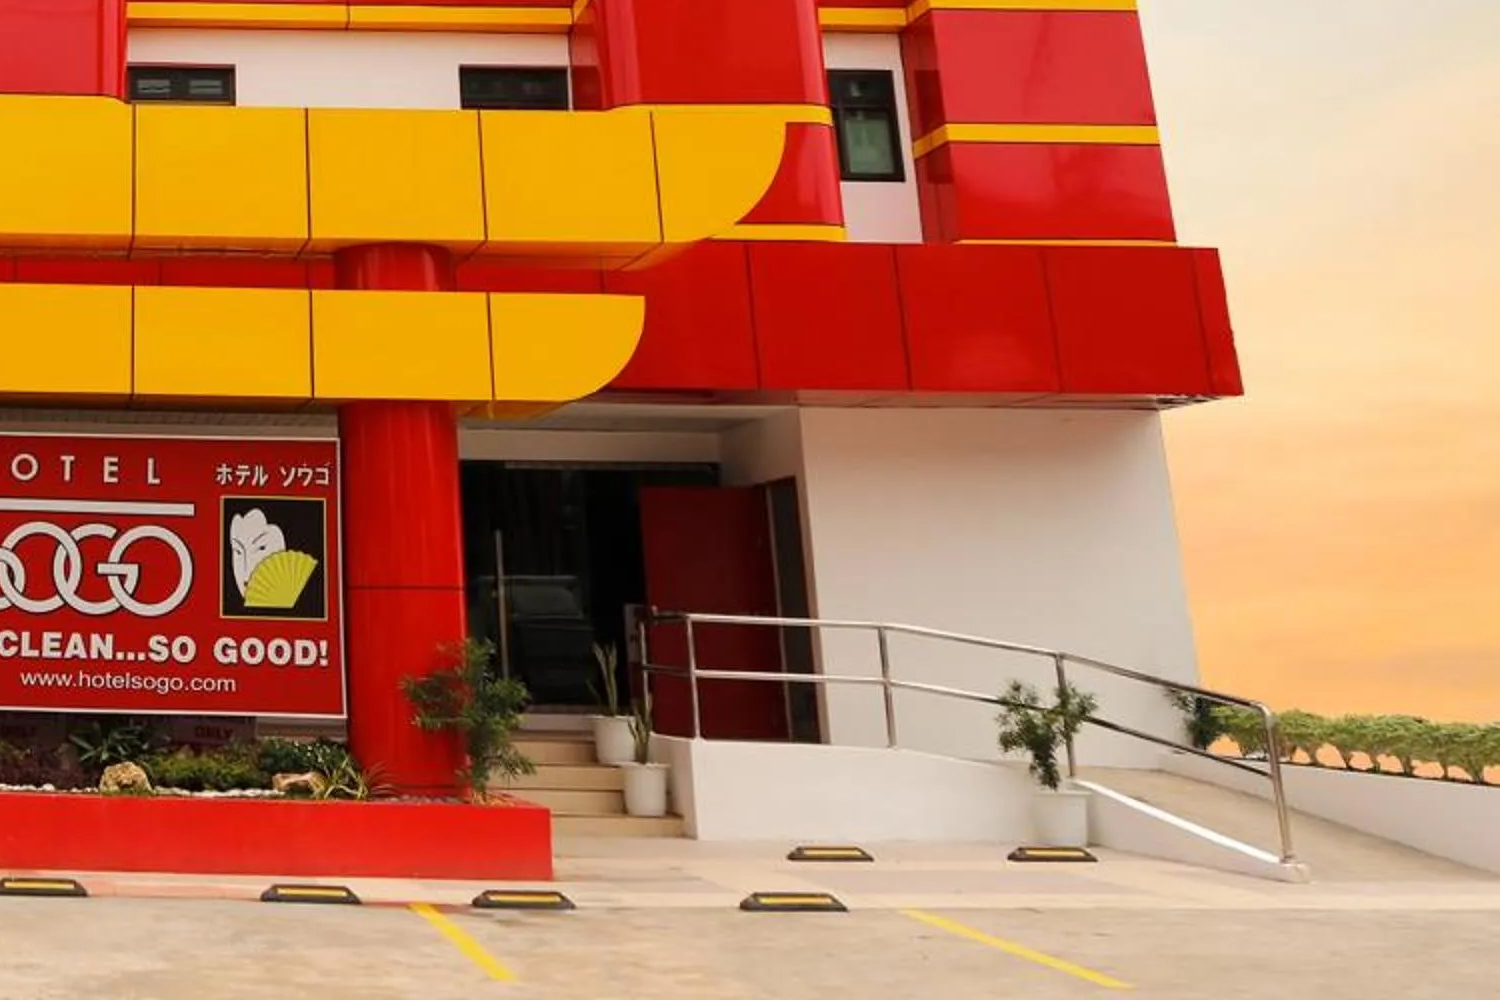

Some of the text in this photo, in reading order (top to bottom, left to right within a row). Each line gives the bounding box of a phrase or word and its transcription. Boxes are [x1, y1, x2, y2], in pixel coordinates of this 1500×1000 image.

[216, 463, 269, 486] ホテル
[213, 637, 329, 667] GOOD!
[20, 671, 237, 694] www.hotelsogo.com
